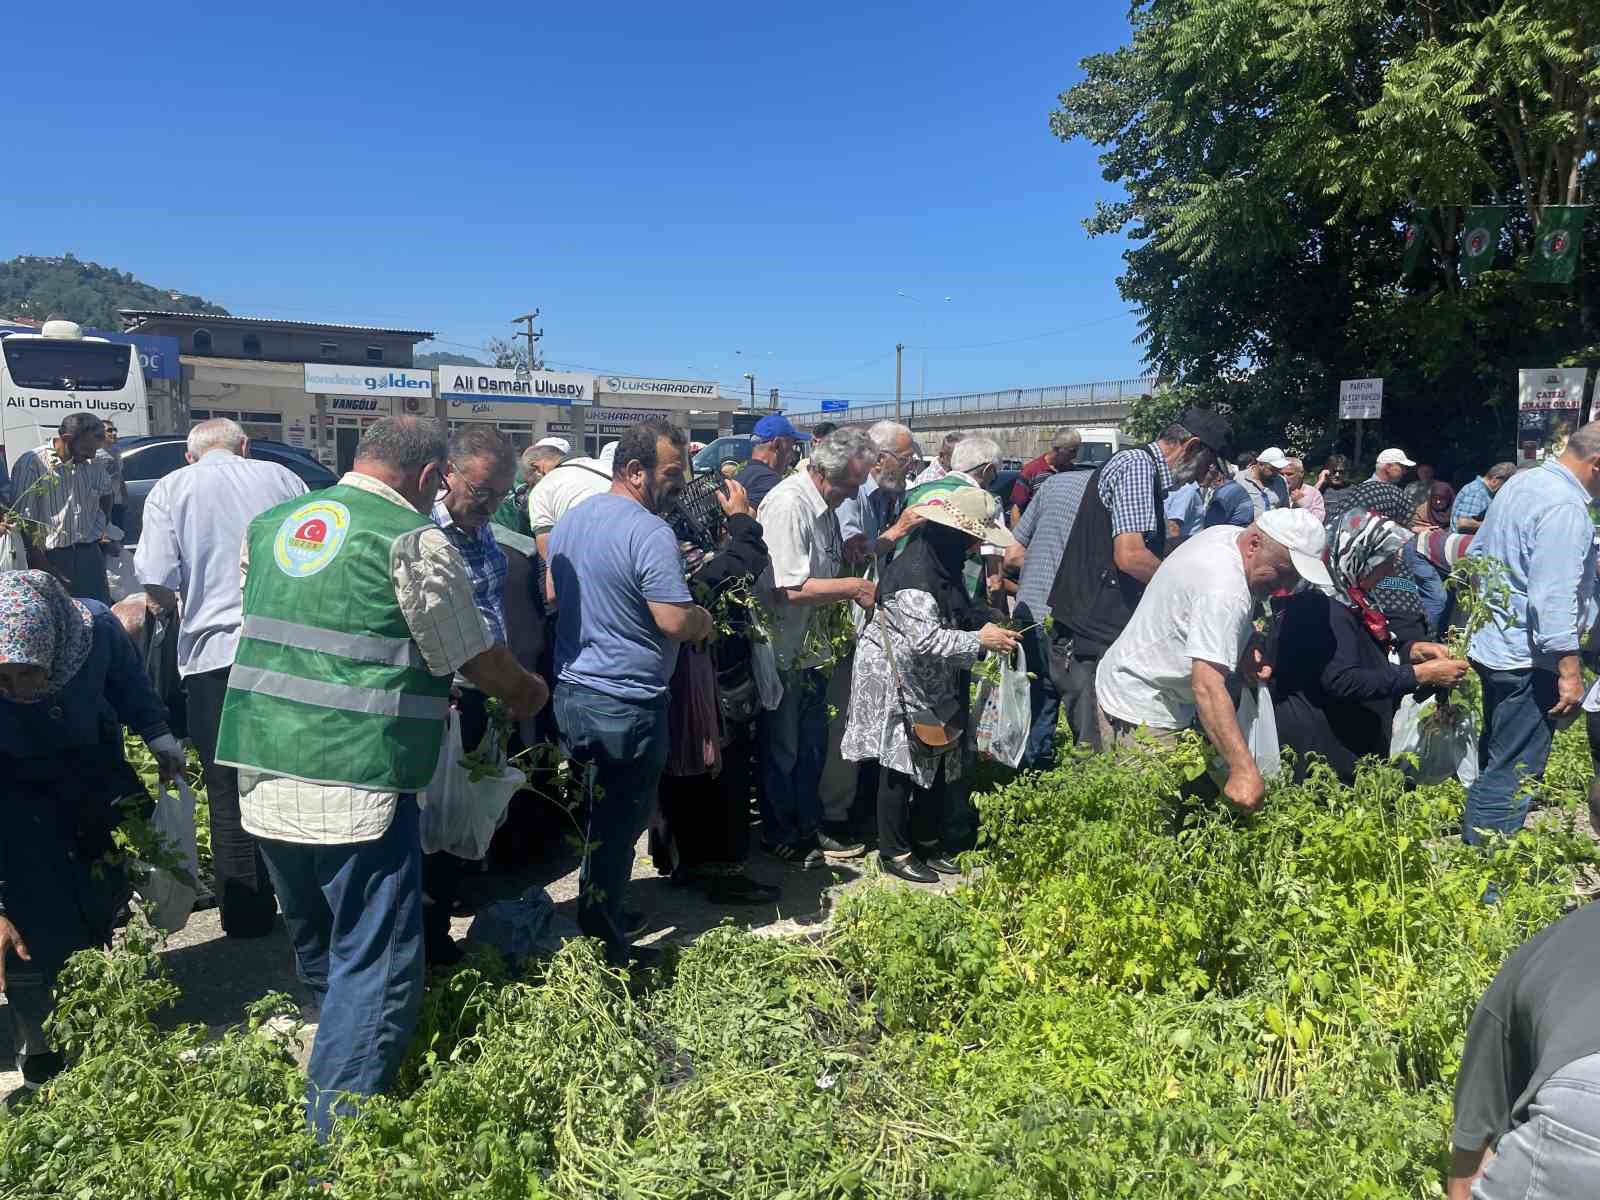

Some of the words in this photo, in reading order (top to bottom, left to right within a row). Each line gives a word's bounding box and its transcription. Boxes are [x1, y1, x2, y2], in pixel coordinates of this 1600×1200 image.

[453, 375, 473, 391] Ali
[477, 376, 532, 394] Osman
[535, 379, 584, 398] Ulusoy
[6, 396, 25, 408] Ali
[29, 397, 82, 409] Osman
[86, 399, 136, 412] Ulusoy
